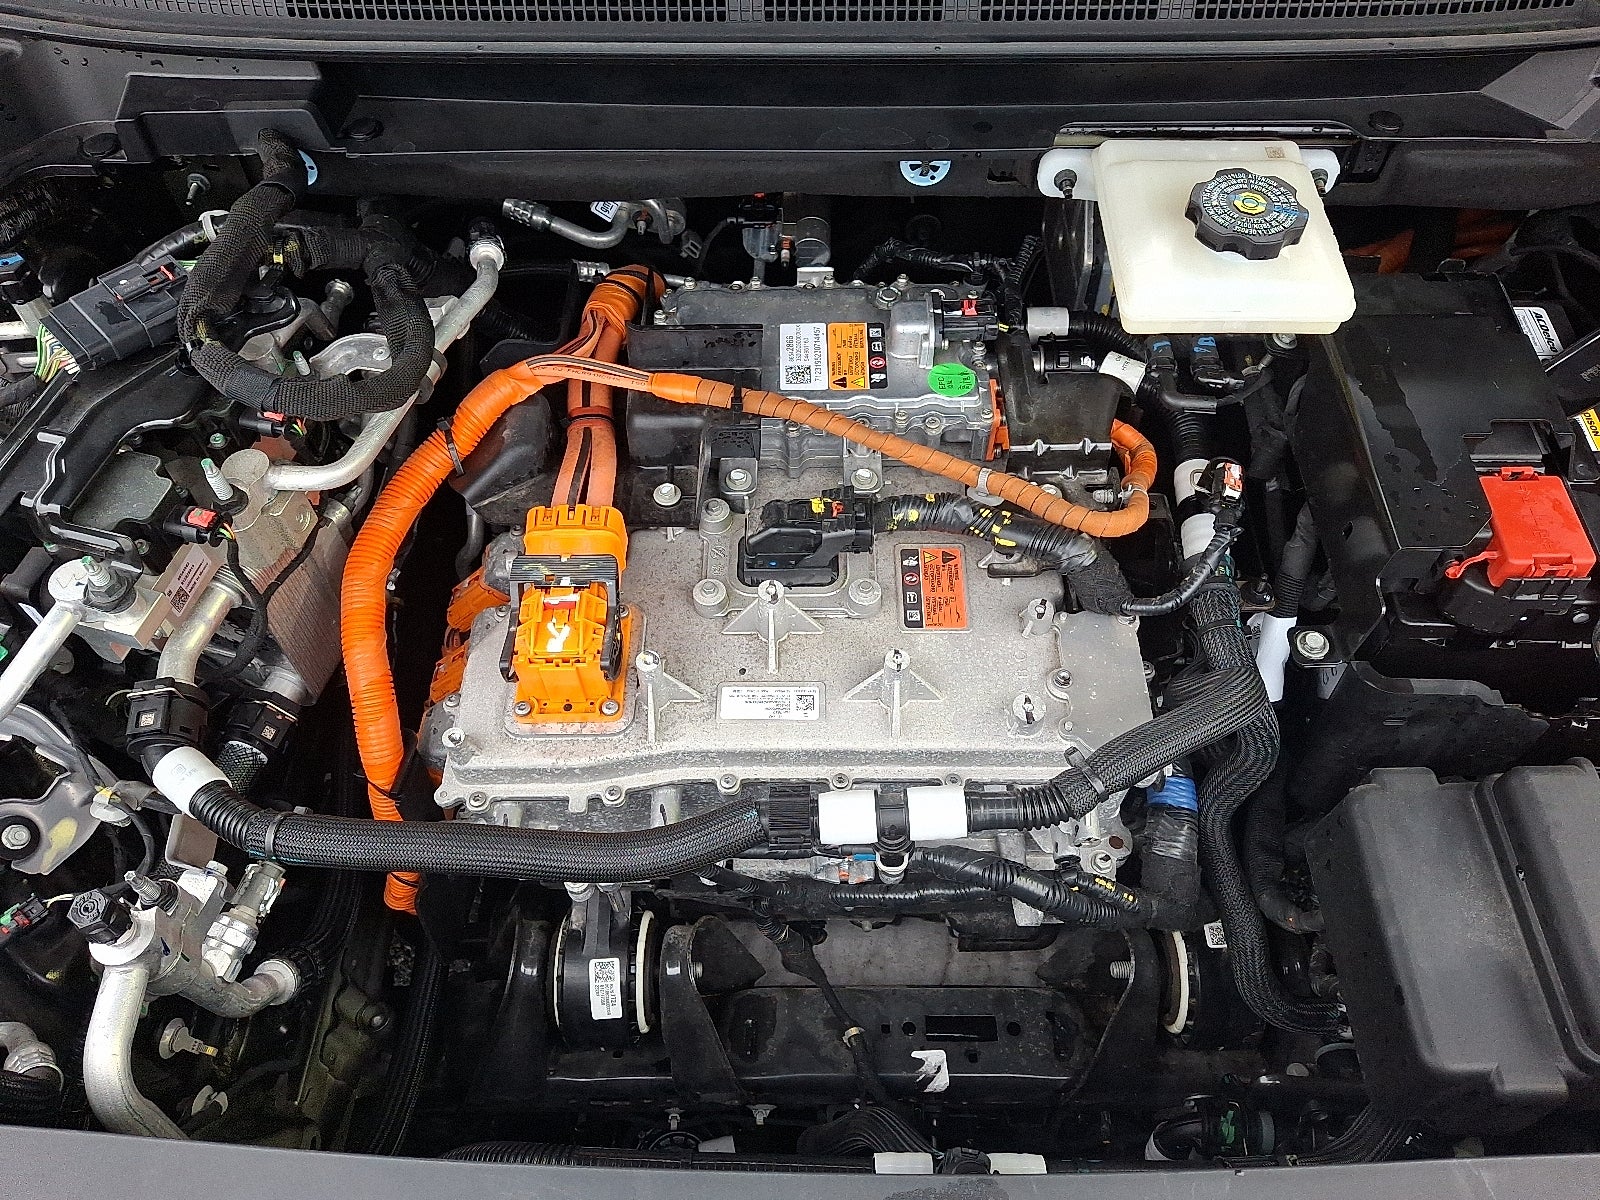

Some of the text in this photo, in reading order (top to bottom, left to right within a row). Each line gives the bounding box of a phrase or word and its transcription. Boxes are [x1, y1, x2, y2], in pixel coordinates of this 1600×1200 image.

[600, 202, 614, 214] gm
[1533, 311, 1558, 353] ACDelco
[1583, 412, 1600, 437] OISON
